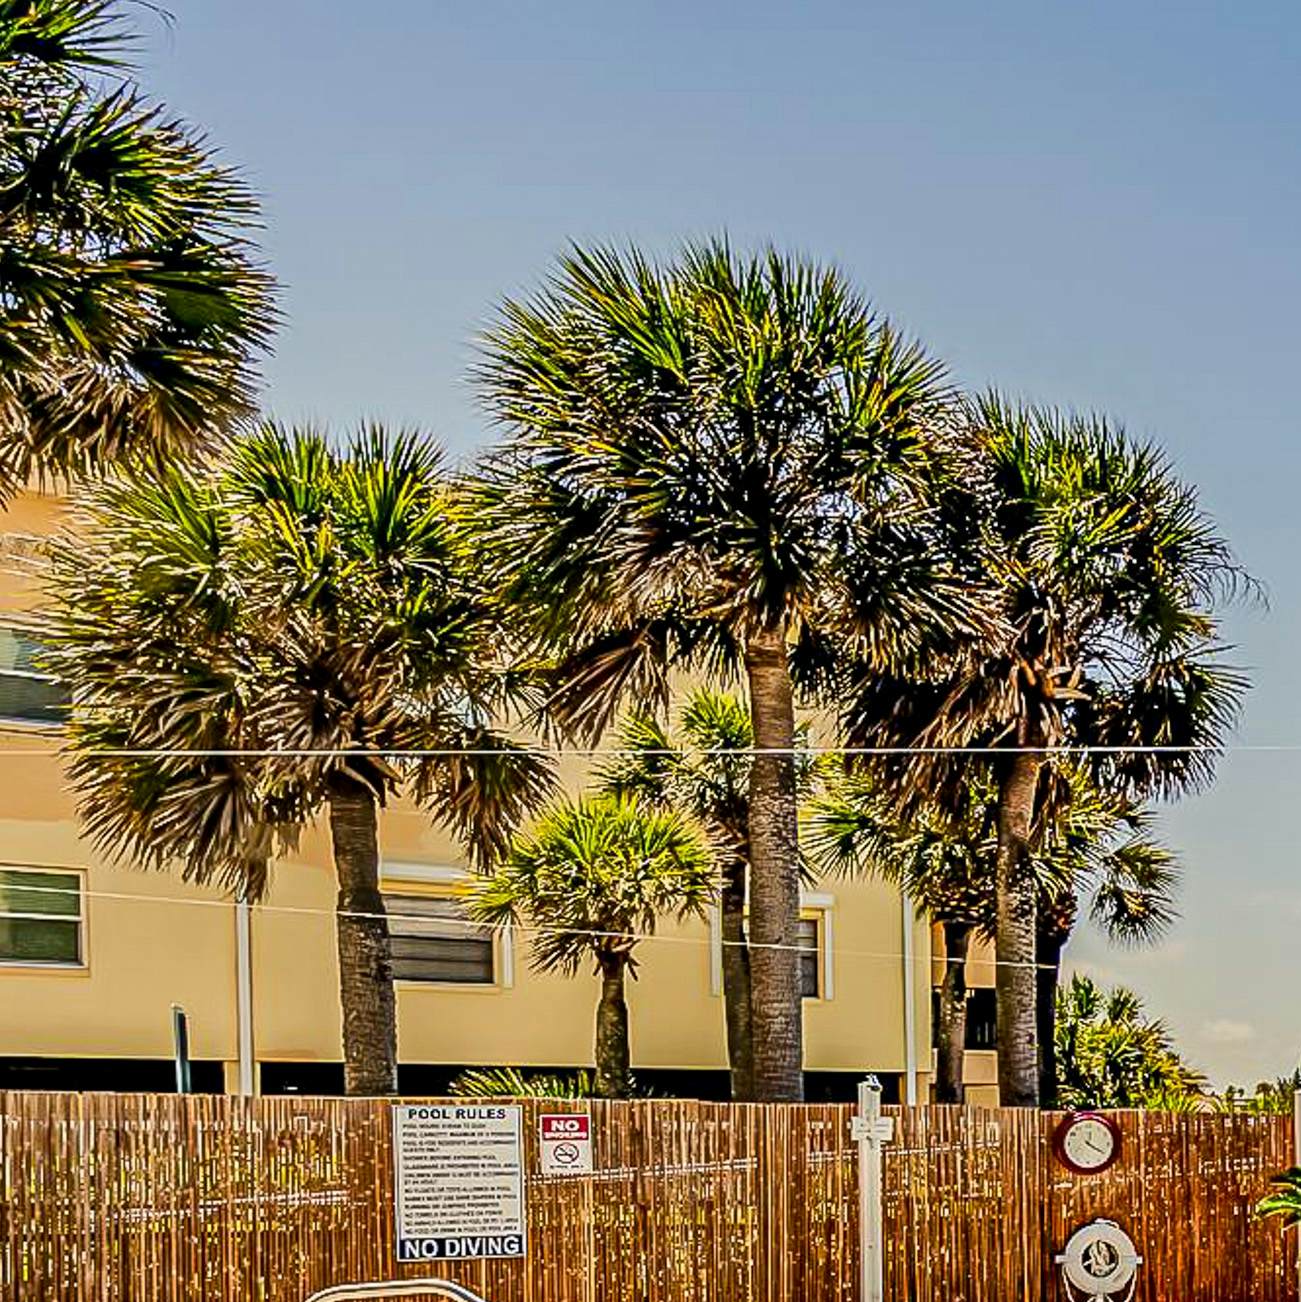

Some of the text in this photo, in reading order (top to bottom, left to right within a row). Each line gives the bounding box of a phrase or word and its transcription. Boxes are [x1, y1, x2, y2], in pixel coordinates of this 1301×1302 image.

[408, 1108, 506, 1120] POOL RULES
[550, 1119, 580, 1132] NO
[404, 1236, 520, 1258] NO DIVING
